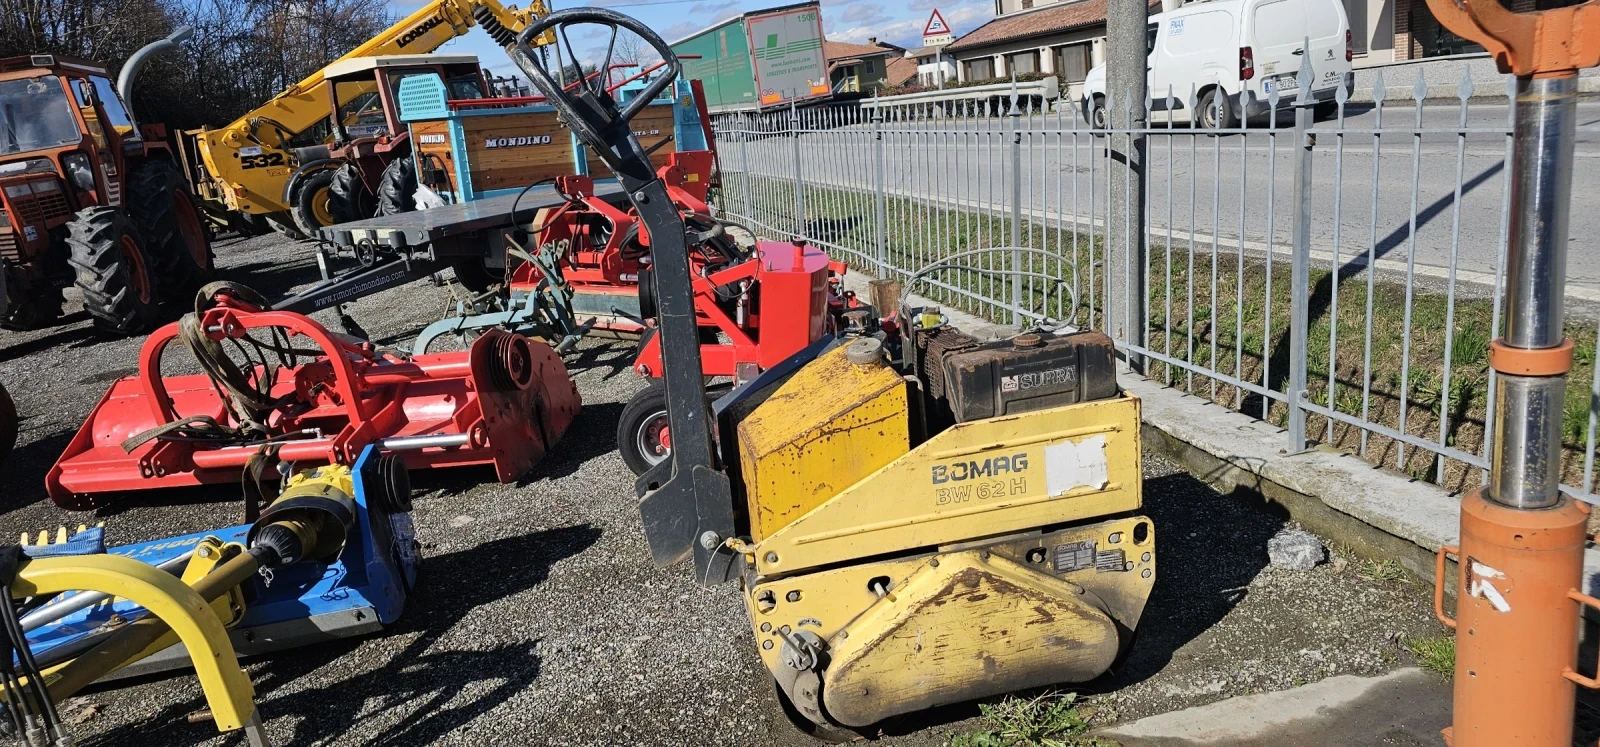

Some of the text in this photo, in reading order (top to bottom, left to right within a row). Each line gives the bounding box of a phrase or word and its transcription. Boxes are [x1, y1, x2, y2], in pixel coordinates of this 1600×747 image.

[797, 13, 816, 22] 1506
[395, 15, 444, 48] LOADALL
[420, 134, 445, 143] MONDINO
[485, 135, 552, 149] MONDINO
[241, 152, 285, 169] 532
[314, 270, 405, 307] www.rimorchimondino.com
[1020, 364, 1076, 389] SUPRA
[931, 452, 1028, 485] BOMAG
[936, 477, 1027, 506] BW 62 H
